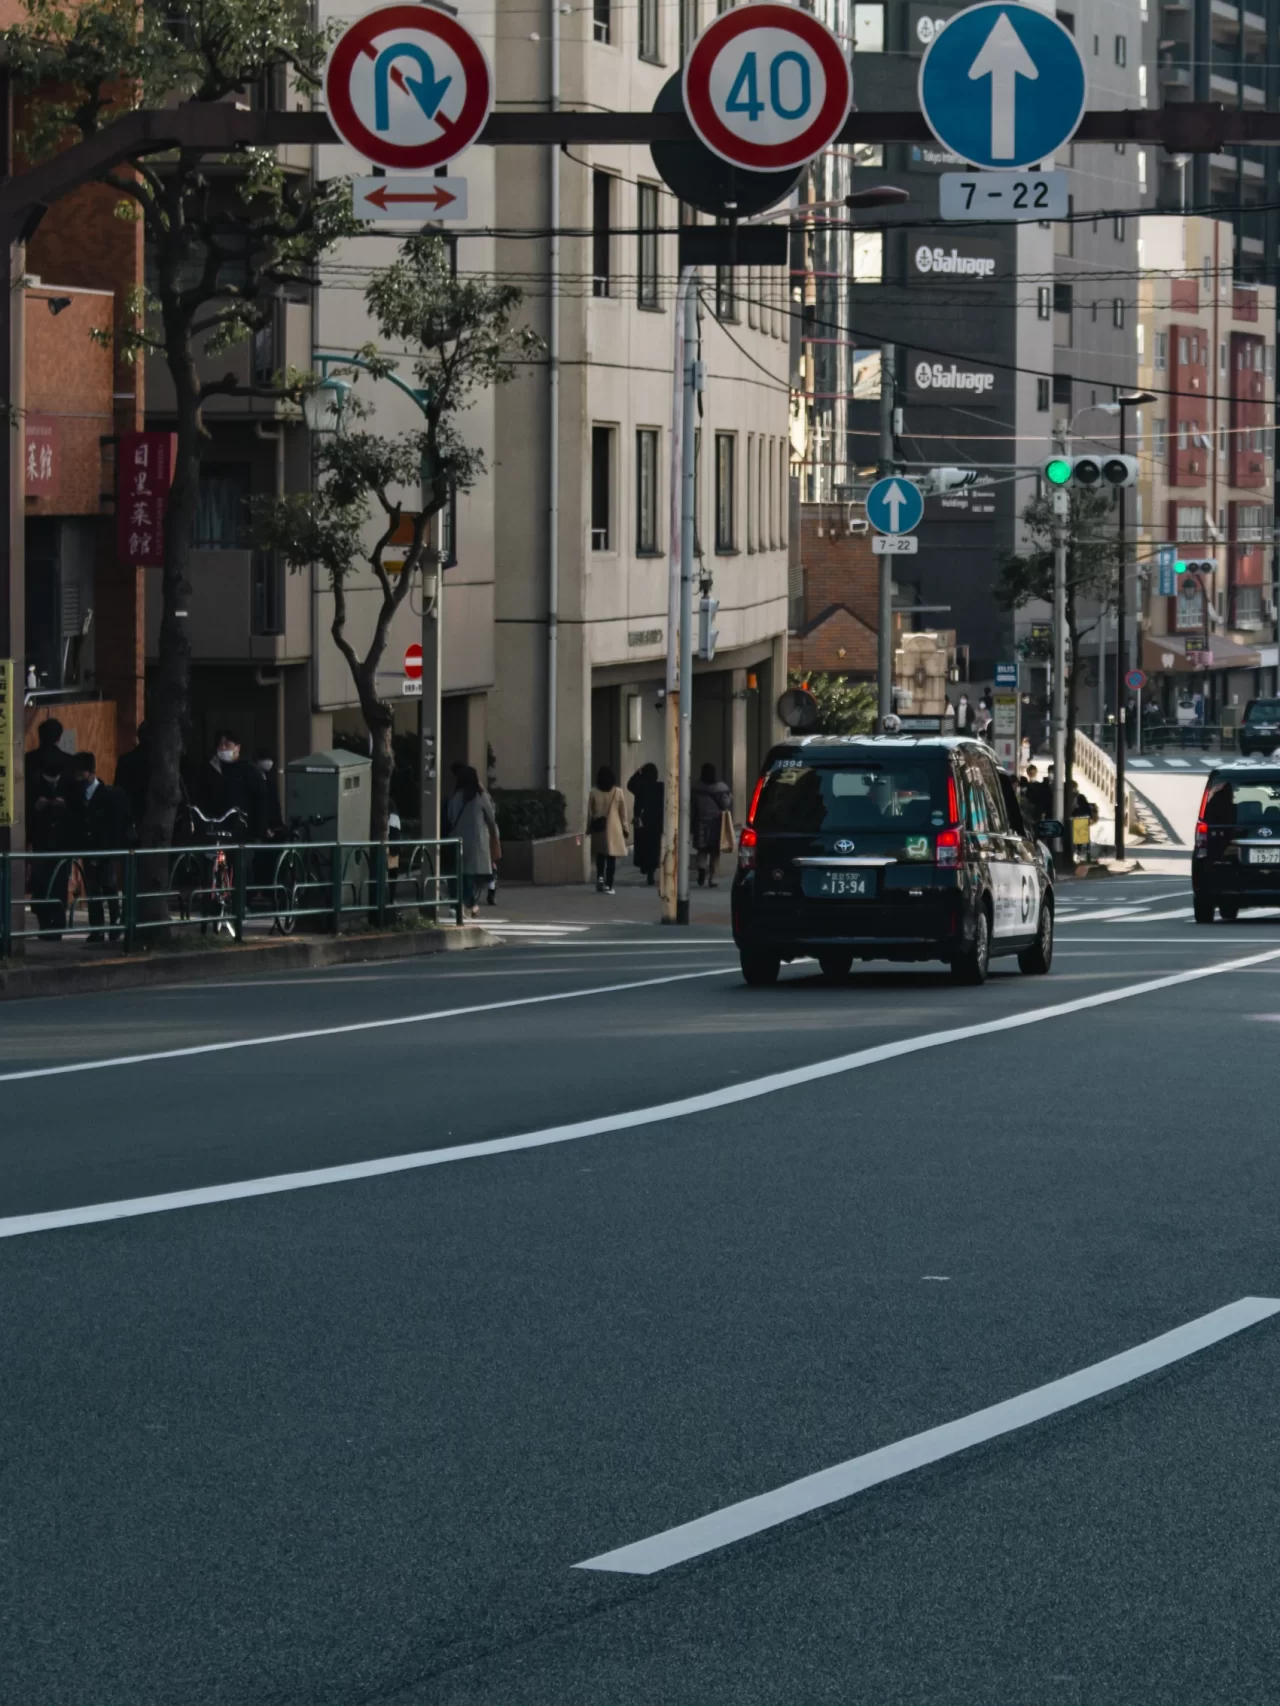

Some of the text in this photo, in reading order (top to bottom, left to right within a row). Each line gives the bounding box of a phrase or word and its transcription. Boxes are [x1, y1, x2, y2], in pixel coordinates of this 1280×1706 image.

[725, 50, 811, 121] 40
[932, 247, 996, 280] Salvage
[931, 364, 994, 394] Salvage
[129, 443, 153, 555] 目黒菜館
[997, 665, 1015, 673] BUS
[778, 760, 803, 768] 1394
[831, 880, 865, 894] 13-94
